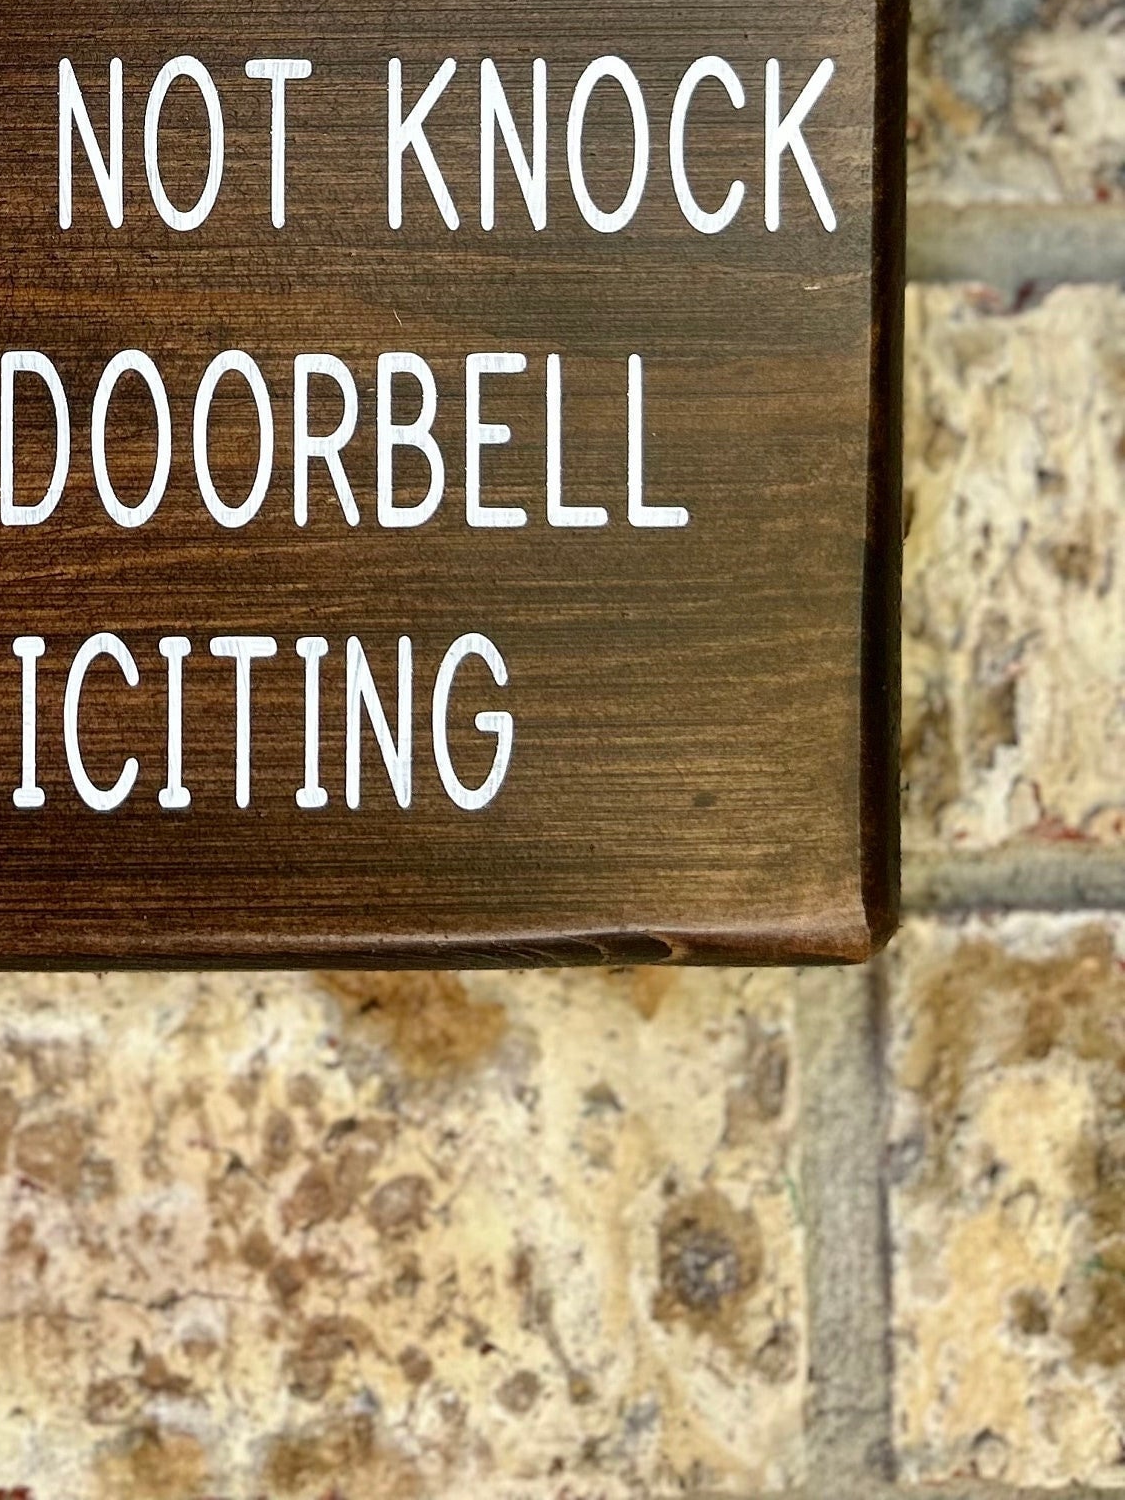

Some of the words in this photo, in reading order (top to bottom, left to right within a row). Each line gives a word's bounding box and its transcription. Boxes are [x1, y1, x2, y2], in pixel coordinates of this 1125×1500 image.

[57, 56, 312, 231] NOT
[387, 56, 837, 234] KNOCK
[0, 350, 689, 528] DOORBELL
